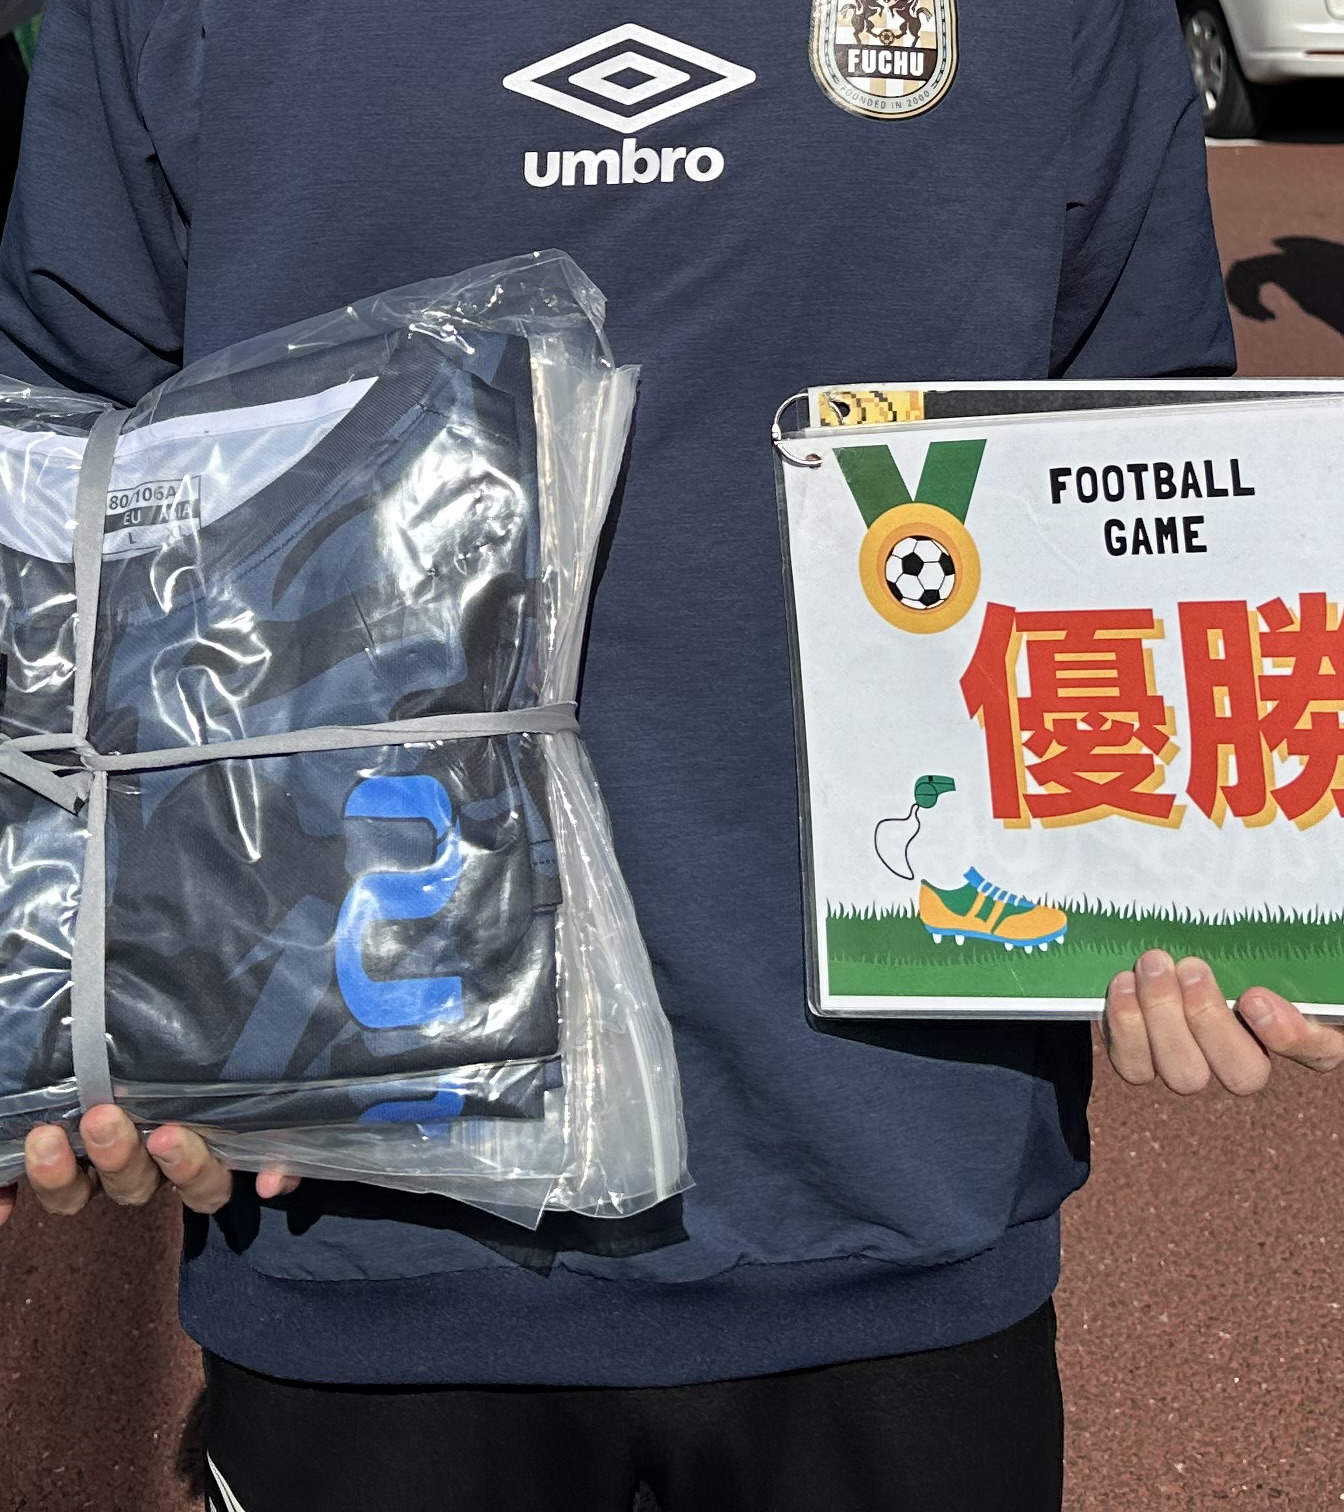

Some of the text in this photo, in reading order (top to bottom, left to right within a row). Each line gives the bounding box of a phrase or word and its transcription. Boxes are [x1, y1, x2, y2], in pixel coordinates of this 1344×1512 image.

[847, 48, 925, 77] FUCHU
[839, 83, 931, 110] FOUNDED IN 2000
[523, 138, 724, 188] umbro
[1049, 458, 1256, 505] FOOTBALL
[123, 509, 142, 526] EU
[129, 532, 136, 544] L
[1103, 514, 1208, 557] GAME
